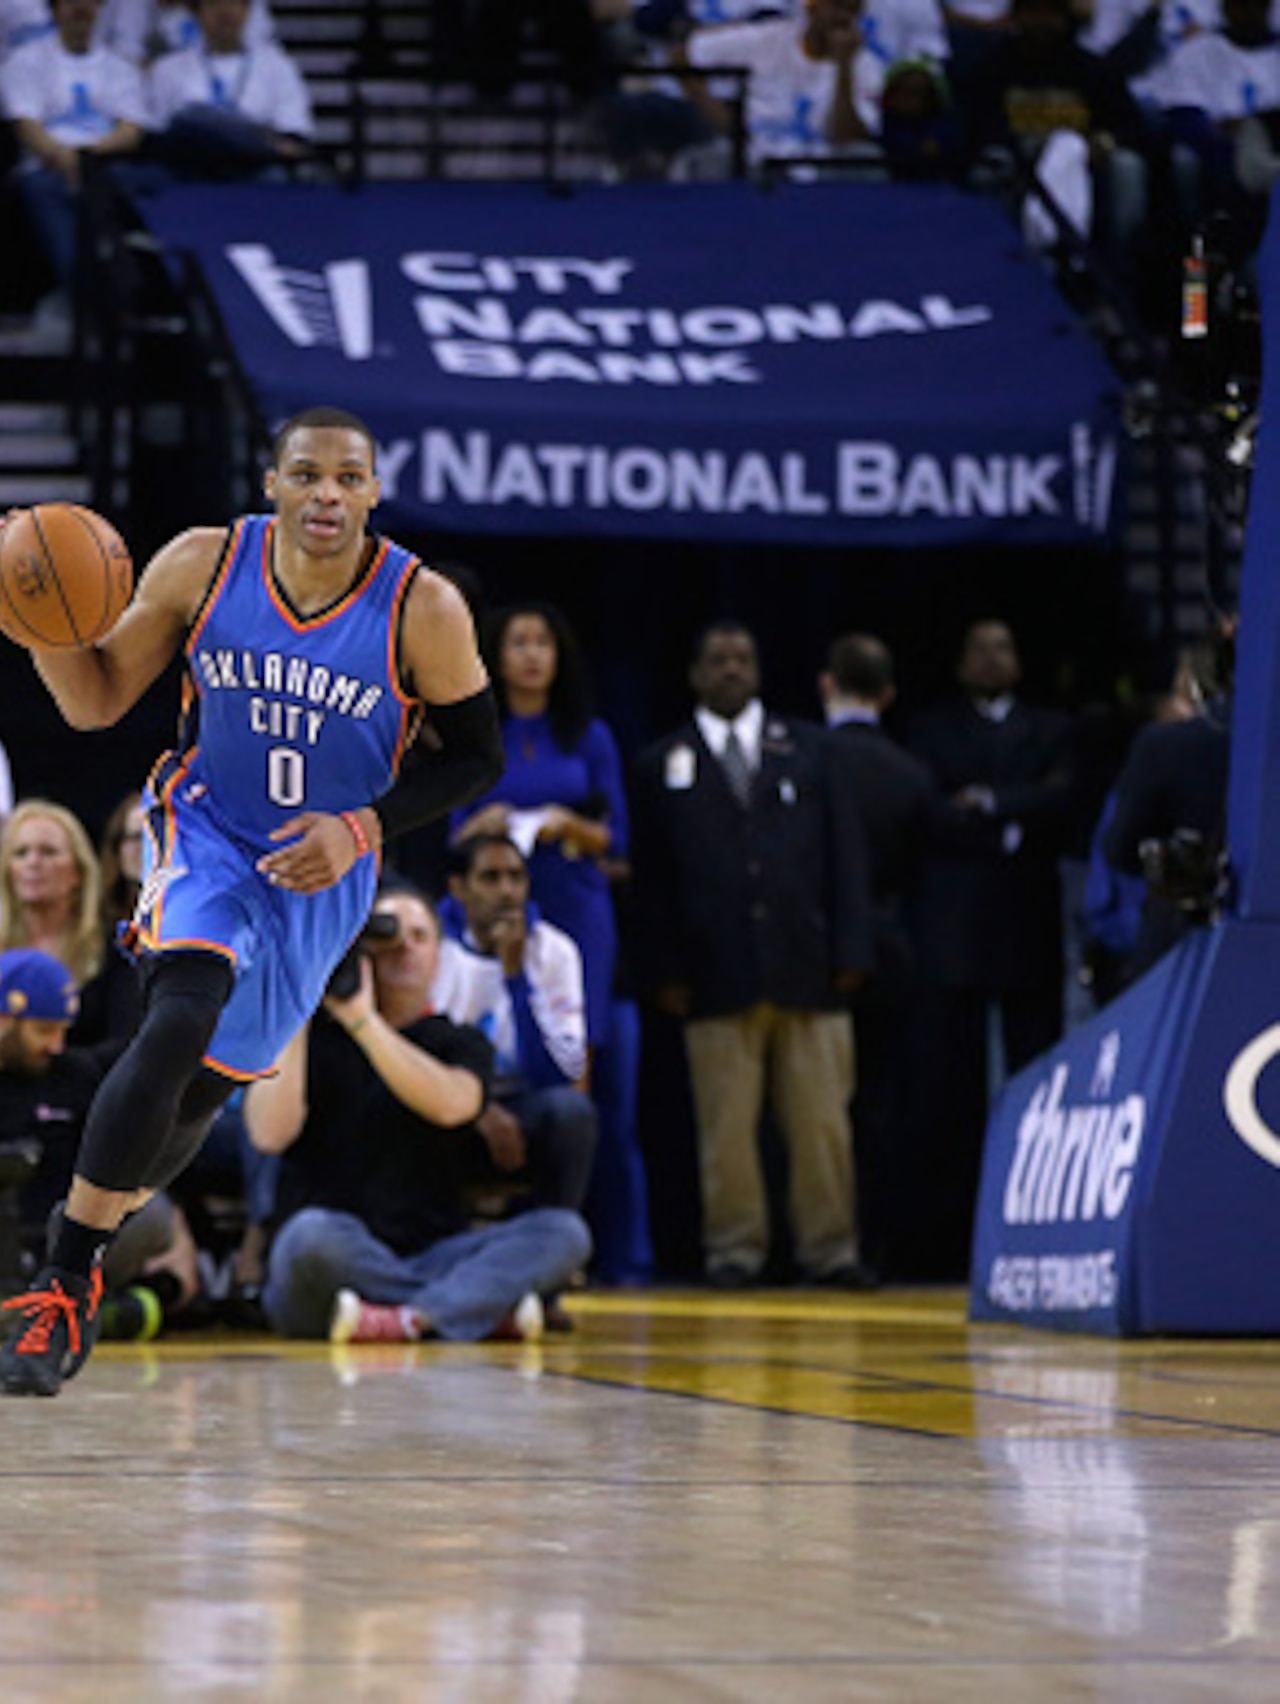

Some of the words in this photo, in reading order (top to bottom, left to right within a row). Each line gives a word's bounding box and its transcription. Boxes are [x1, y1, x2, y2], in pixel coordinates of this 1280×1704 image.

[415, 295, 993, 346] NATIONAL
[431, 339, 761, 385] BANK
[421, 428, 827, 514] NATIONAL
[836, 439, 1062, 518] BANK
[199, 649, 383, 720] OKLAHOMA
[250, 695, 325, 745] CITY
[267, 746, 305, 807] 0
[1003, 1063, 1146, 1225] thrive
